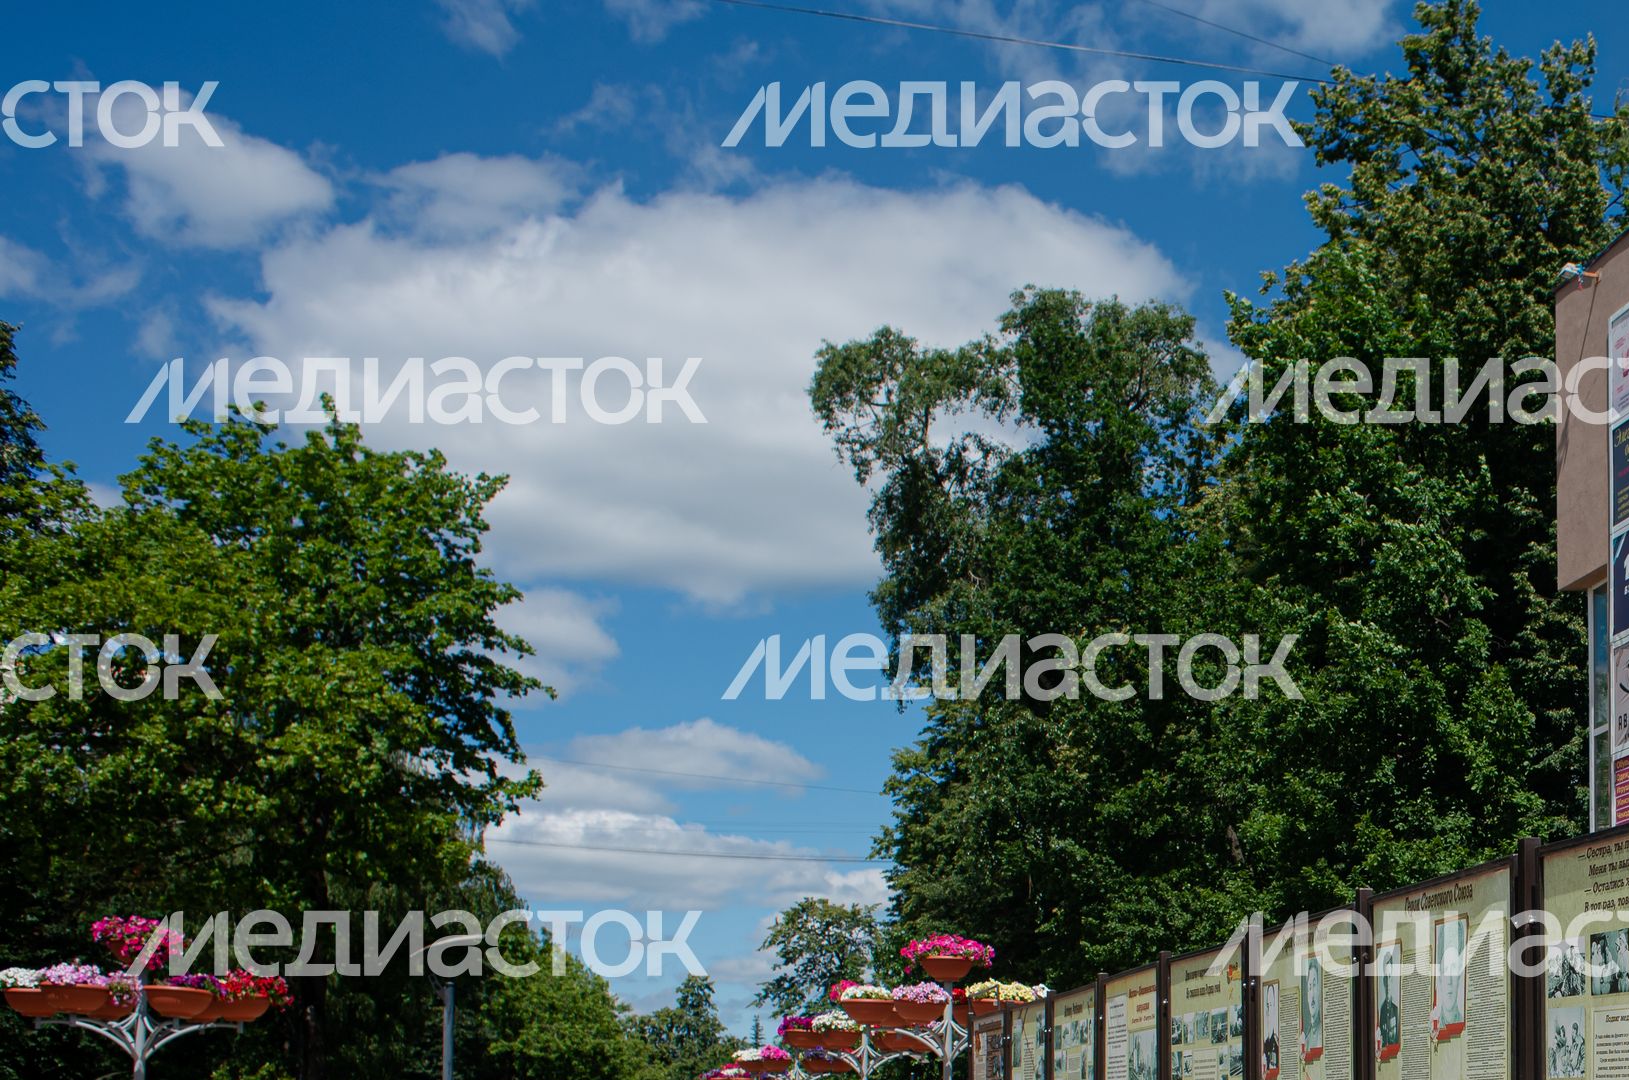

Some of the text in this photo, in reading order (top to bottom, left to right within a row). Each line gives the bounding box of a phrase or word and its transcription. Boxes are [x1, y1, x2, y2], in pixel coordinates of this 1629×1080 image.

[1586, 842, 1612, 860] Сестра,
[1614, 841, 1623, 852] ты
[1588, 862, 1606, 877] Меня
[1608, 861, 1617, 872] ты
[1592, 877, 1624, 893] Остались
[1420, 886, 1453, 910] Советского
[1454, 879, 1472, 901] Союза
